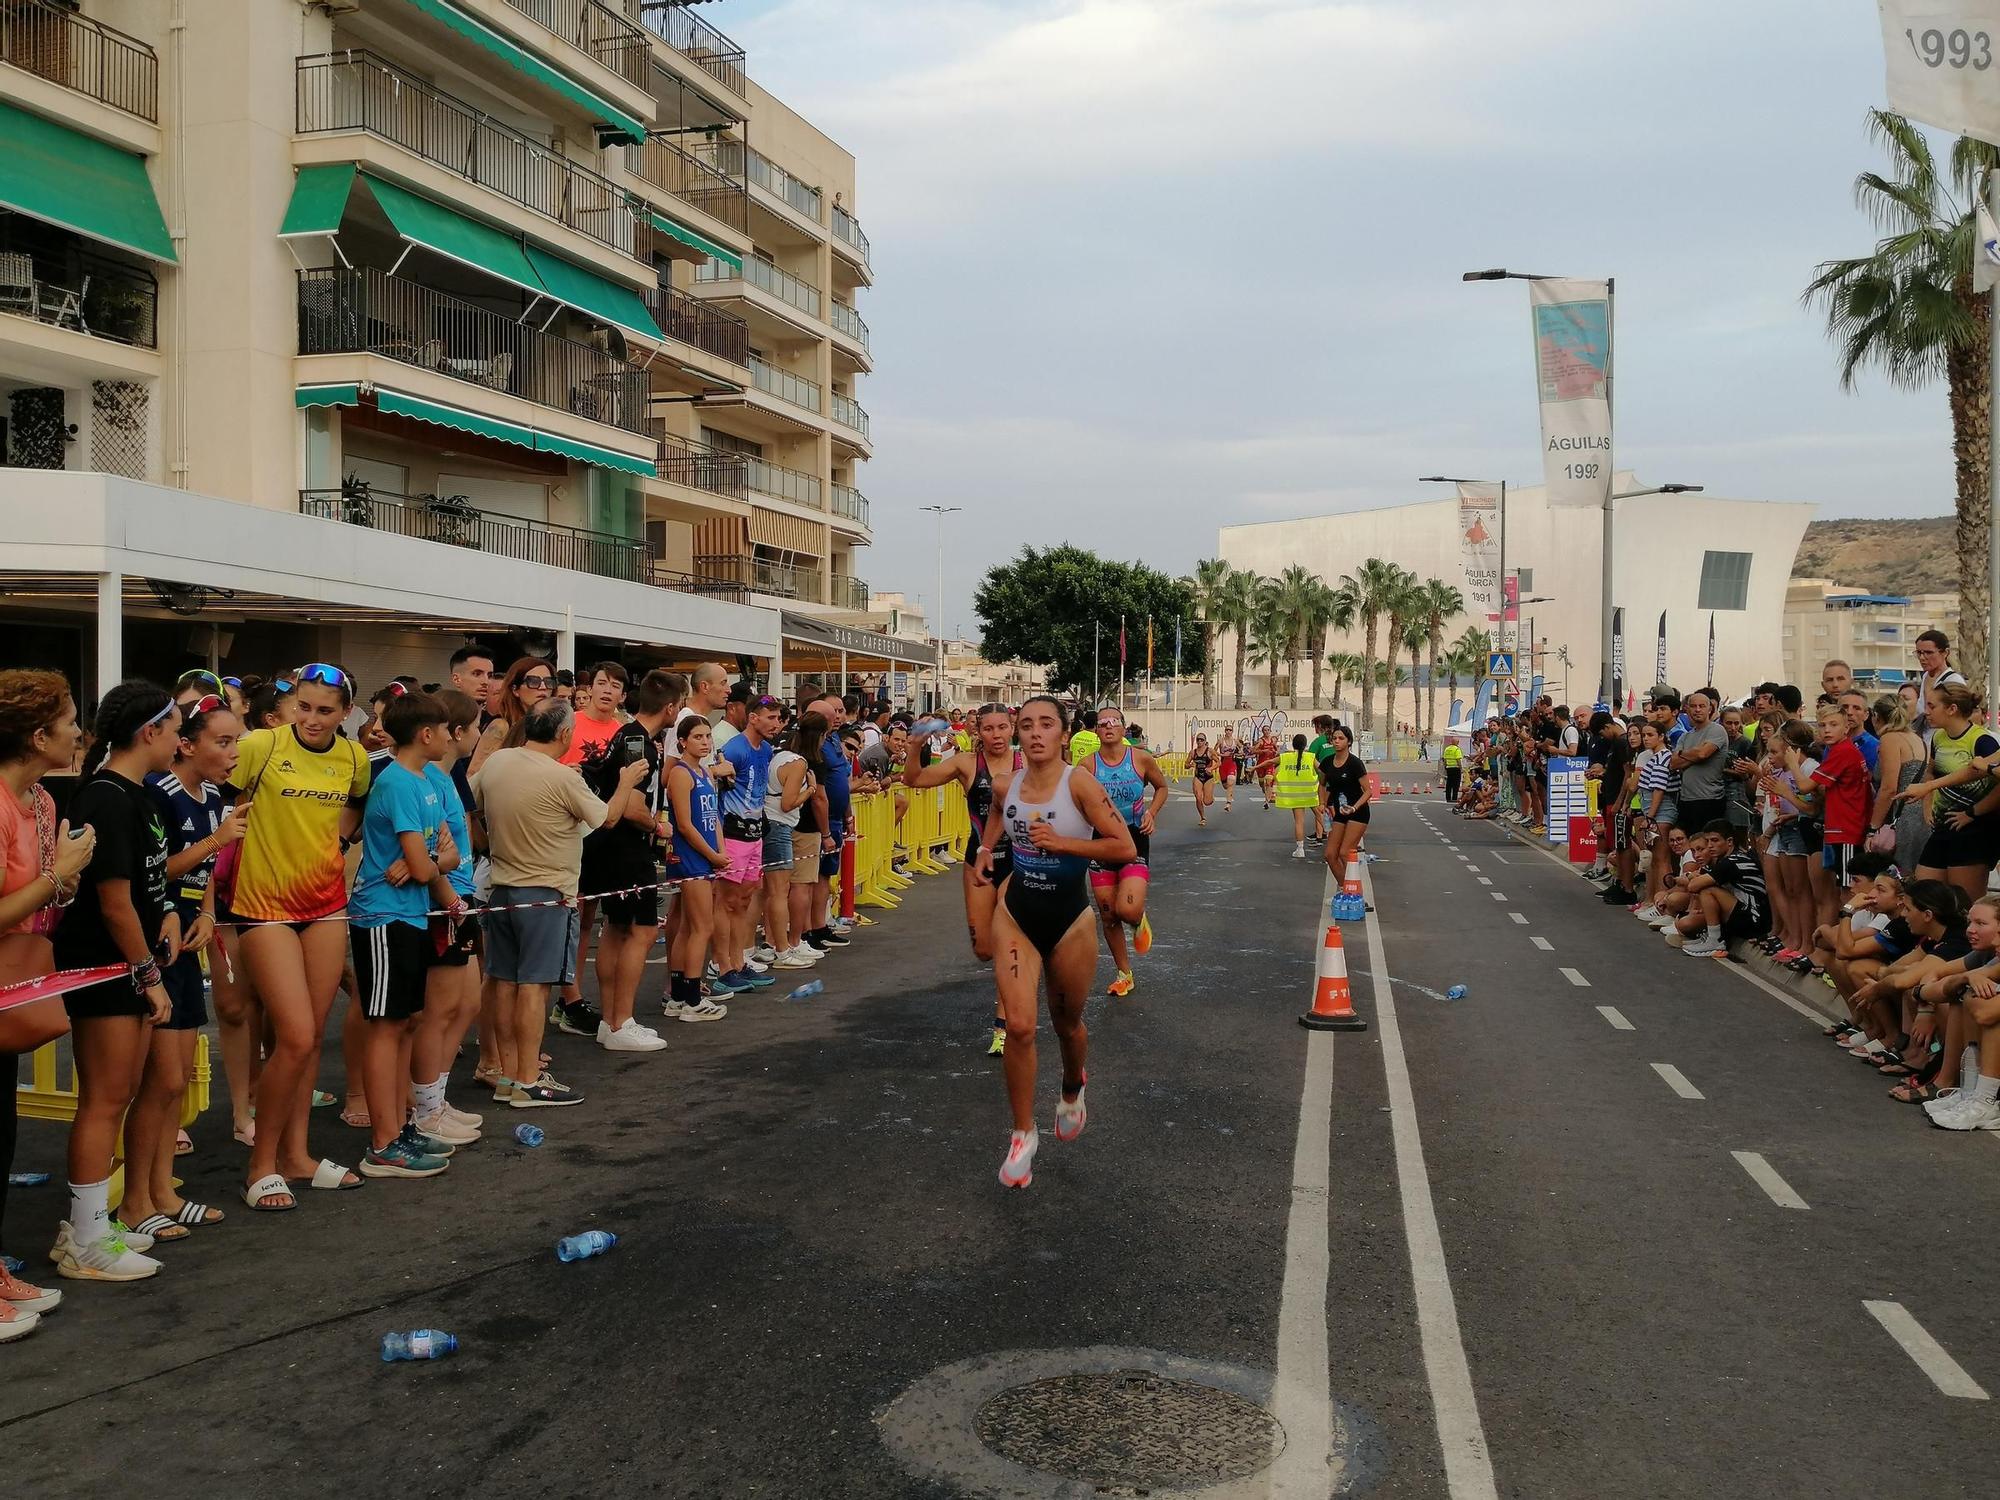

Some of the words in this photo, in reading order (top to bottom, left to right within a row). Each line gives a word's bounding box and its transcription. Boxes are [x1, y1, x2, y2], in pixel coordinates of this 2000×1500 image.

[1548, 436, 1610, 451] ÁGUILAS
[1465, 566, 1497, 578] ÁGUILAS
[1468, 578, 1494, 587] LORCA
[835, 628, 852, 645] BAR
[862, 634, 904, 655] CAFETERIA
[1187, 719, 1227, 728] ADITORIO
[1107, 787, 1135, 800] ZAGA
[1013, 820, 1029, 833] DEL
